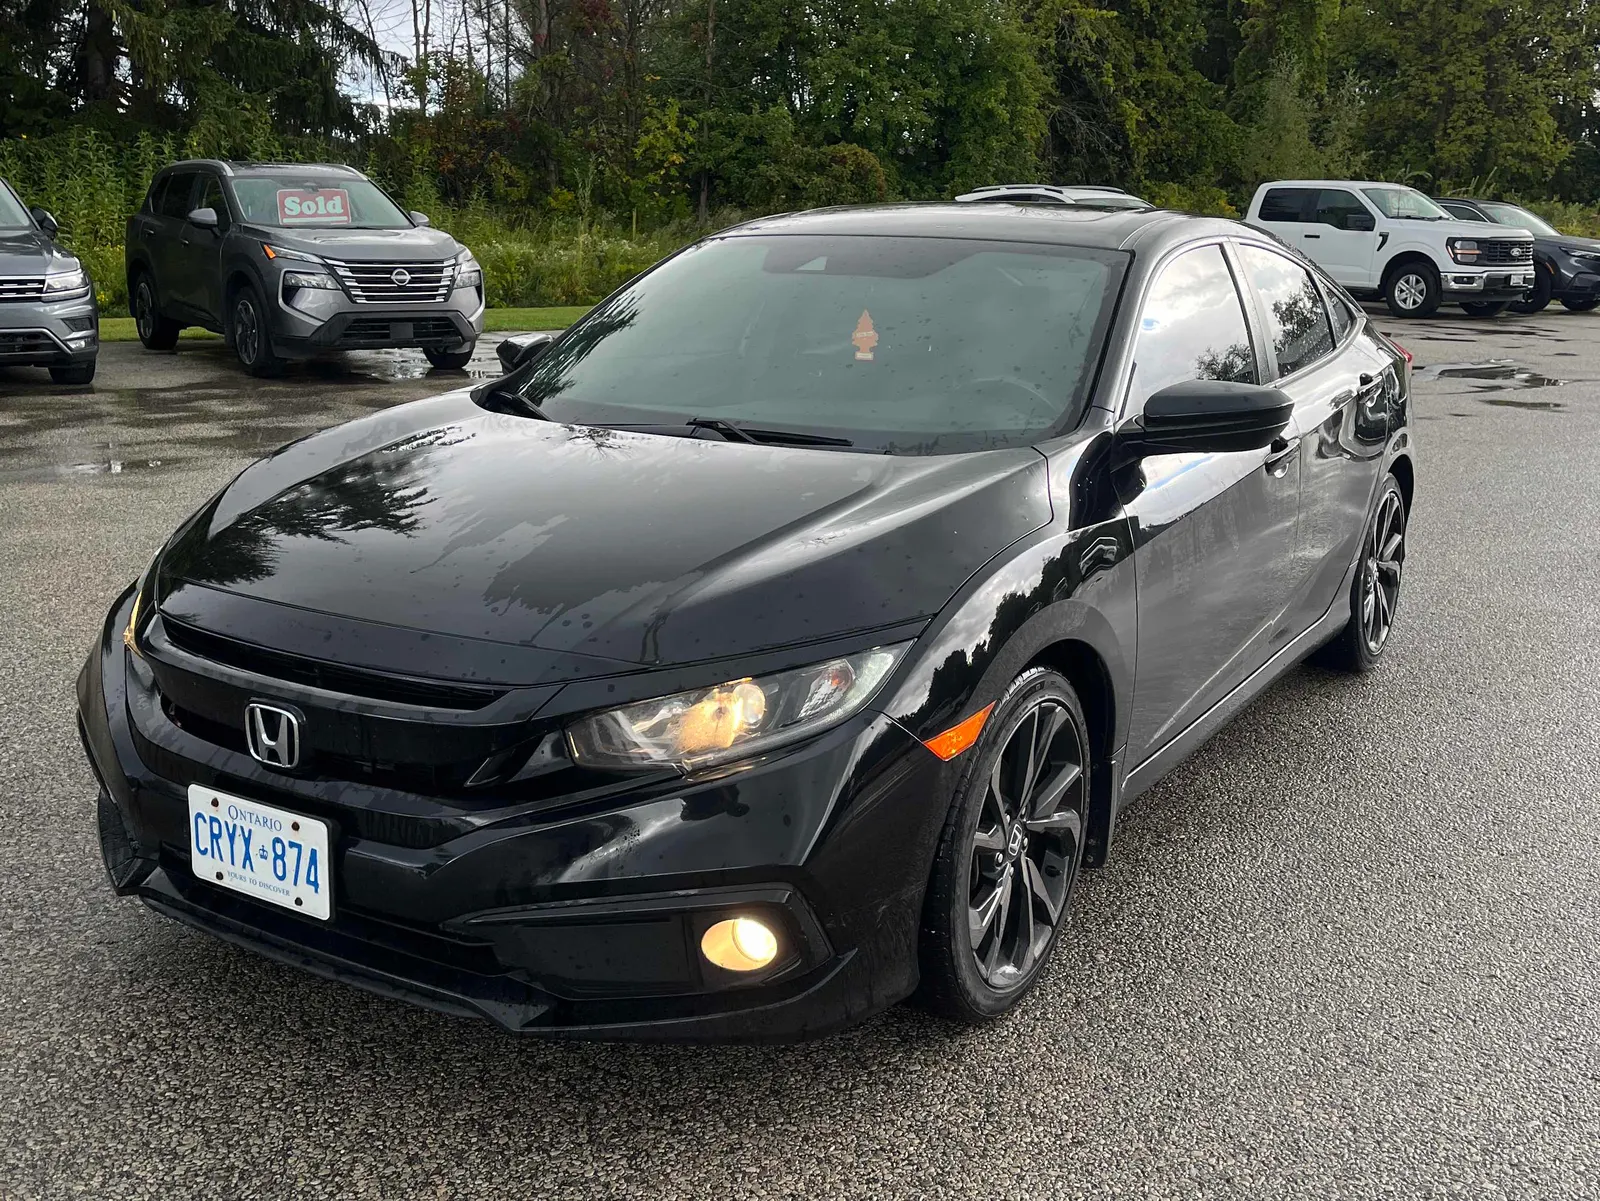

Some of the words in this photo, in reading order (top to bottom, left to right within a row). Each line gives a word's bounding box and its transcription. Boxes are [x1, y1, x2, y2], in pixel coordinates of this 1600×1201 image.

[284, 195, 344, 216] Sold
[194, 811, 255, 872] CRYX
[272, 836, 319, 894] 874
[227, 870, 247, 883] YOURS
[249, 877, 258, 886] TO
[259, 881, 291, 896] DISCOVER
